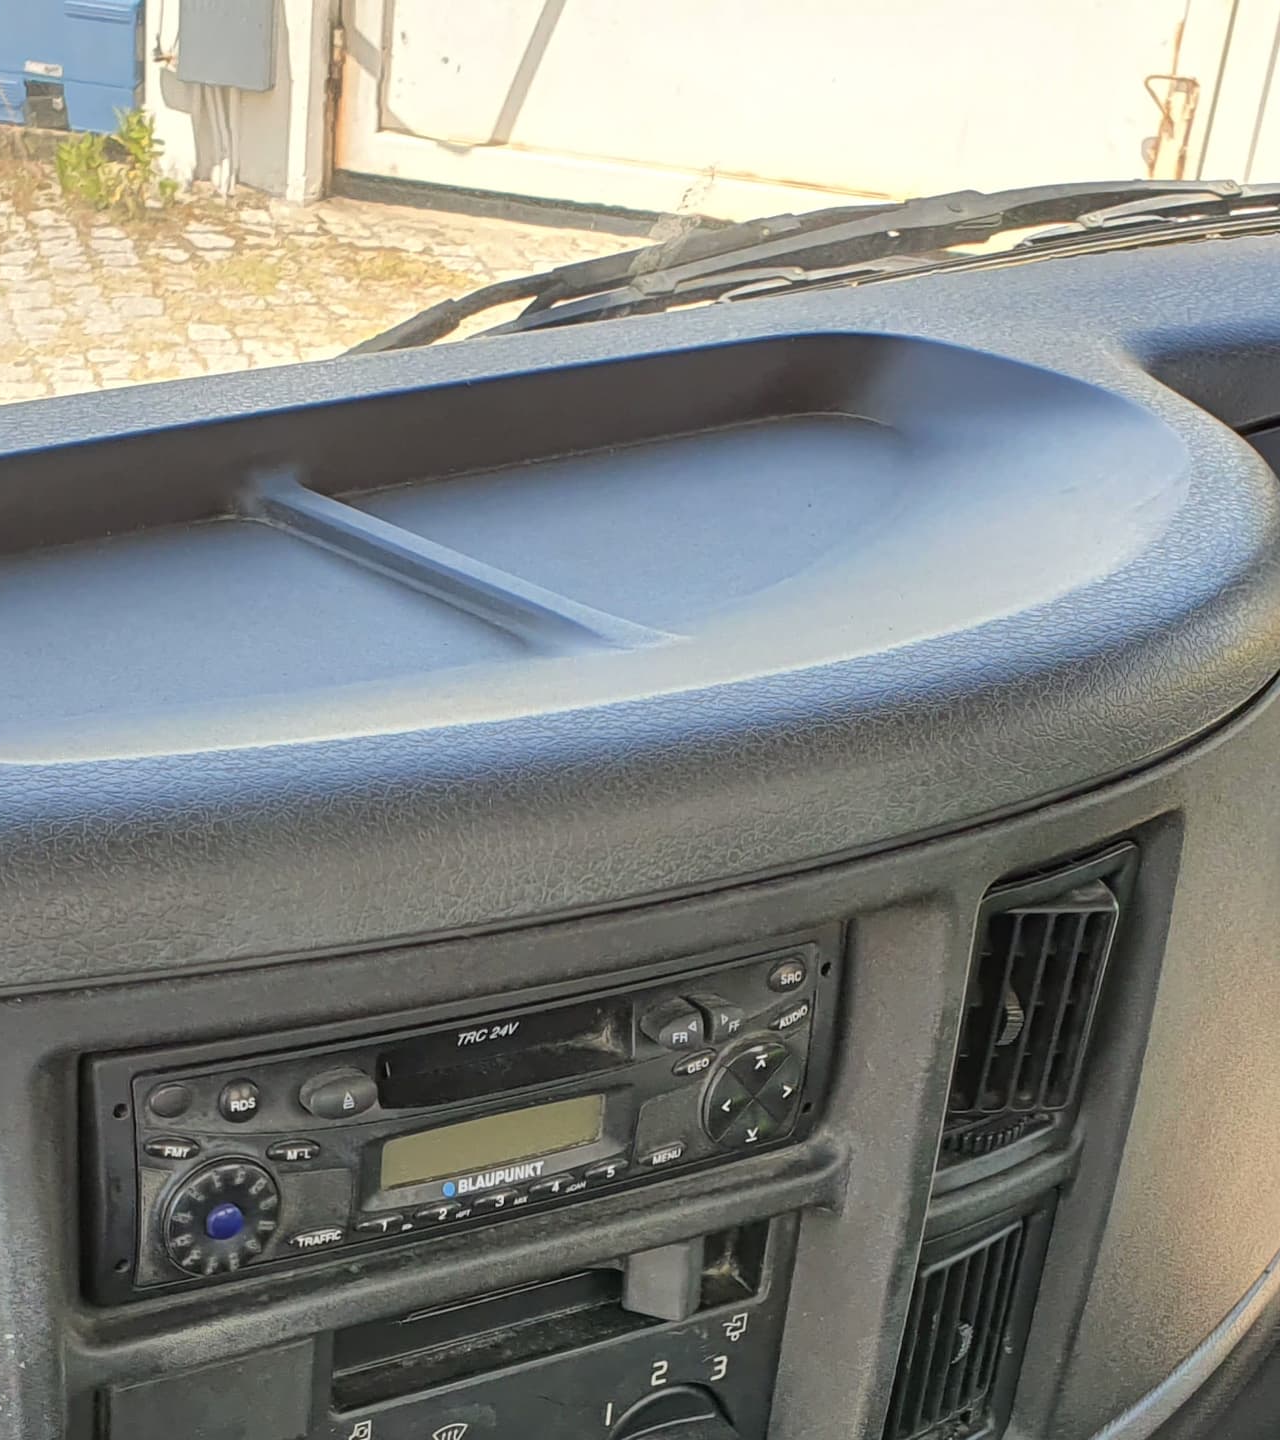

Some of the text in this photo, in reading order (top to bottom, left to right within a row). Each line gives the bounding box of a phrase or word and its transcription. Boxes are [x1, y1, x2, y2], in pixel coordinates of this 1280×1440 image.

[780, 970, 803, 986] SRC
[778, 1004, 809, 1030] AUDIO
[457, 1020, 520, 1047] TRC 24V
[672, 1031, 689, 1045] FR
[687, 1057, 710, 1075] GEO
[230, 1096, 257, 1113] RDS
[652, 1147, 683, 1166] MENU
[457, 1160, 545, 1194] BLAUPUNKT
[606, 1164, 616, 1179] 5
[551, 1180, 561, 1193] 4
[494, 1194, 505, 1208] 3
[438, 1208, 448, 1221] 2
[296, 1228, 342, 1248] TRAFFIC
[650, 1360, 669, 1387] 2
[710, 1355, 728, 1382] 3
